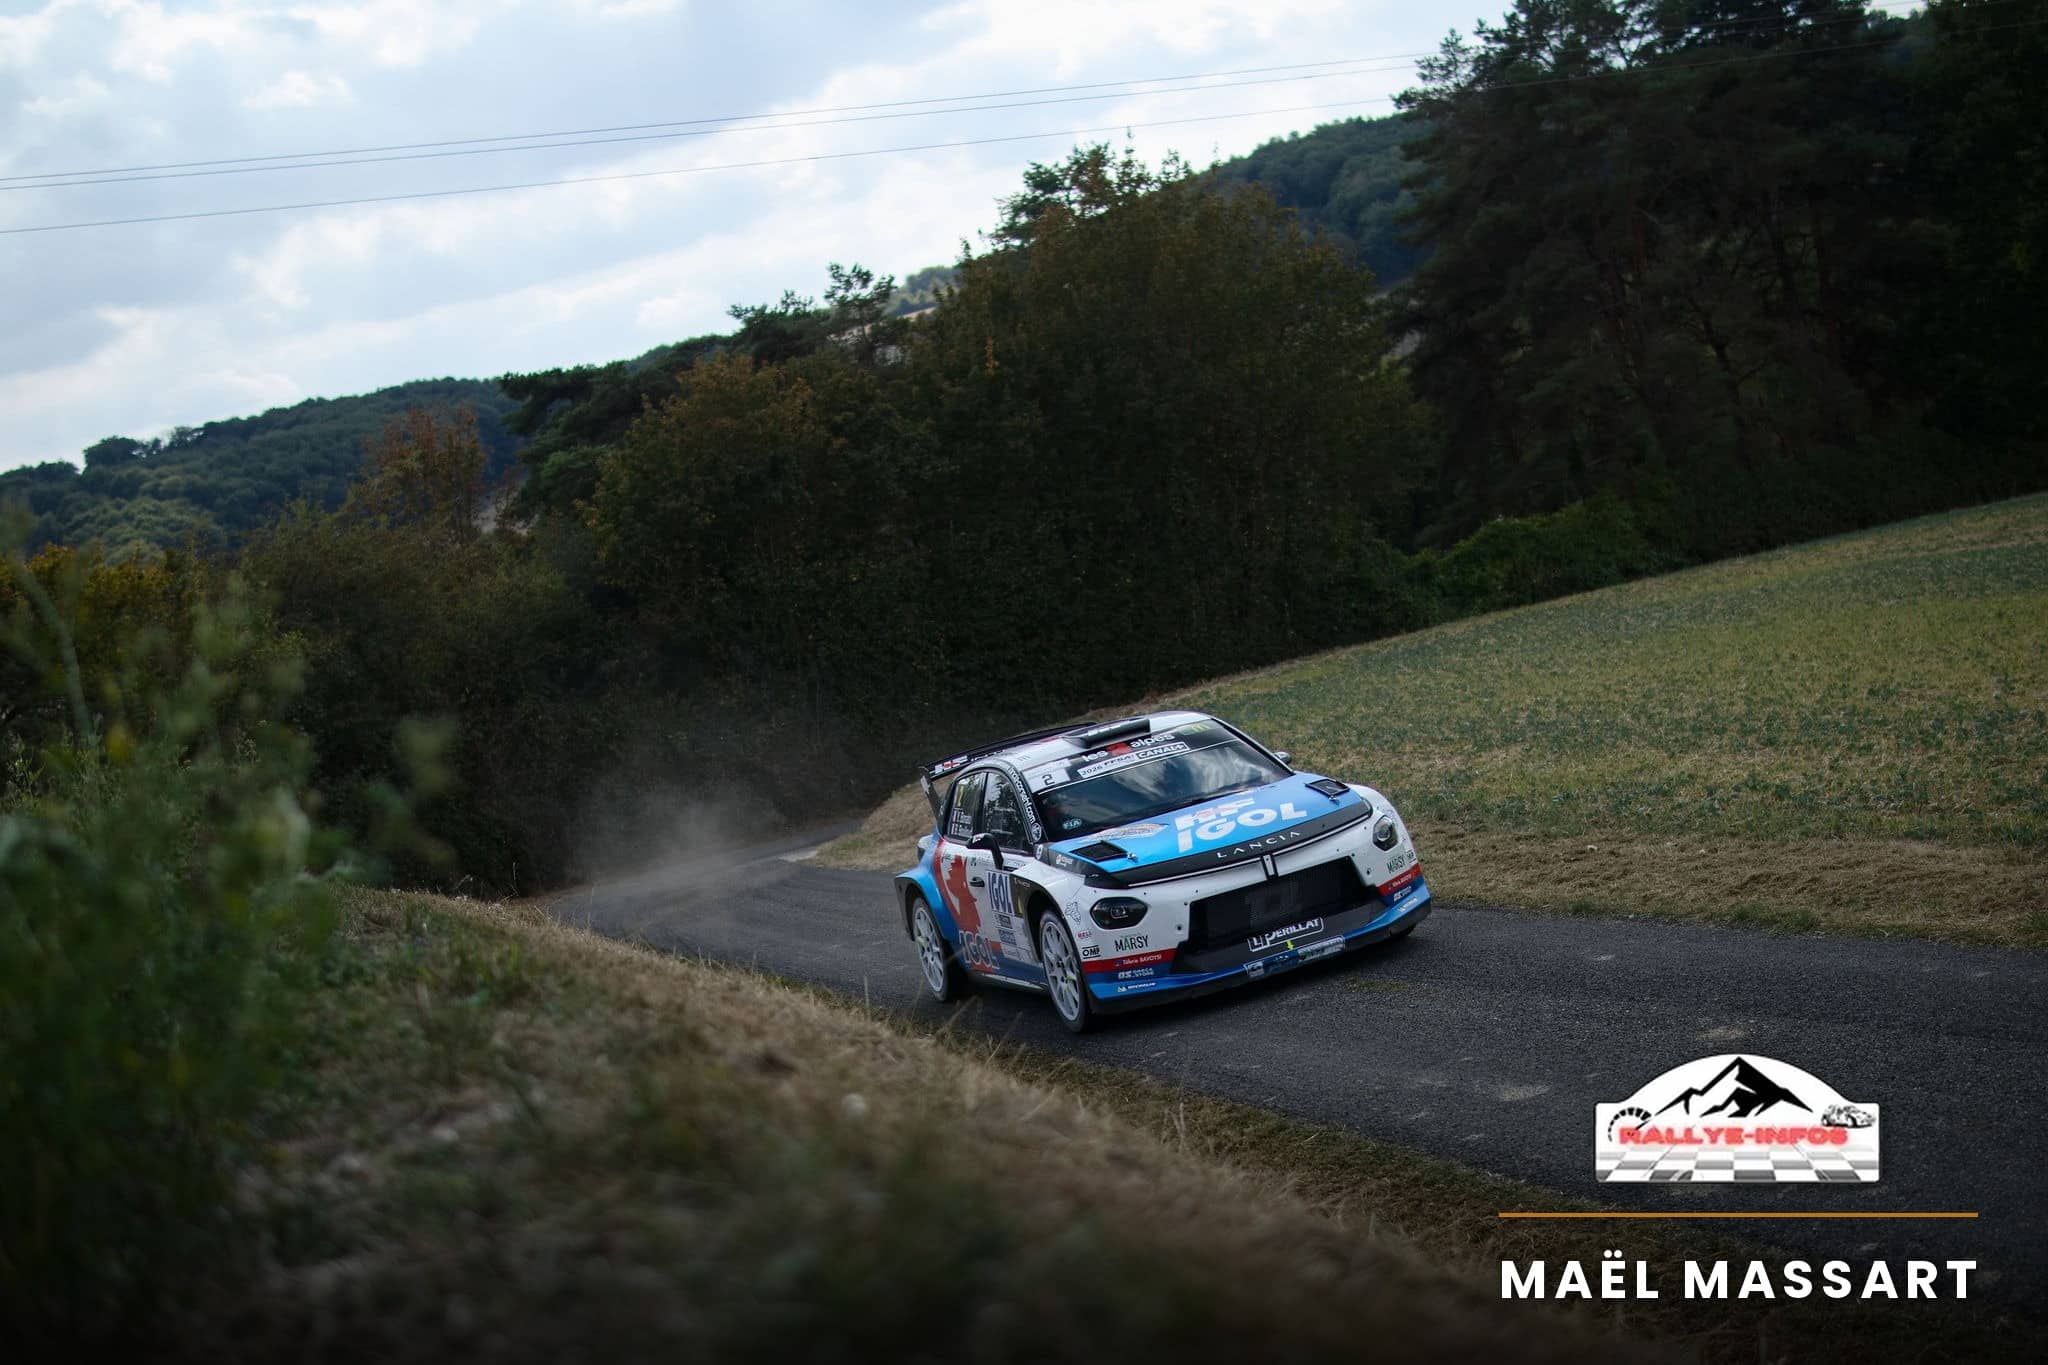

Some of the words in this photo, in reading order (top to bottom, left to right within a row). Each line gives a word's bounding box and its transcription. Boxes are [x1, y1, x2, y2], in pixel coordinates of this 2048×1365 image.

[1130, 734, 1175, 748] alpes
[1138, 744, 1186, 759] CANAL+
[1042, 774, 1055, 785] 2
[1177, 802, 1307, 853] IGOL
[1217, 831, 1300, 858] LANCIA
[988, 872, 1012, 913] IGOL
[959, 931, 1001, 970] IGOL
[1115, 936, 1149, 951] MARSY
[1083, 946, 1100, 957] OMP
